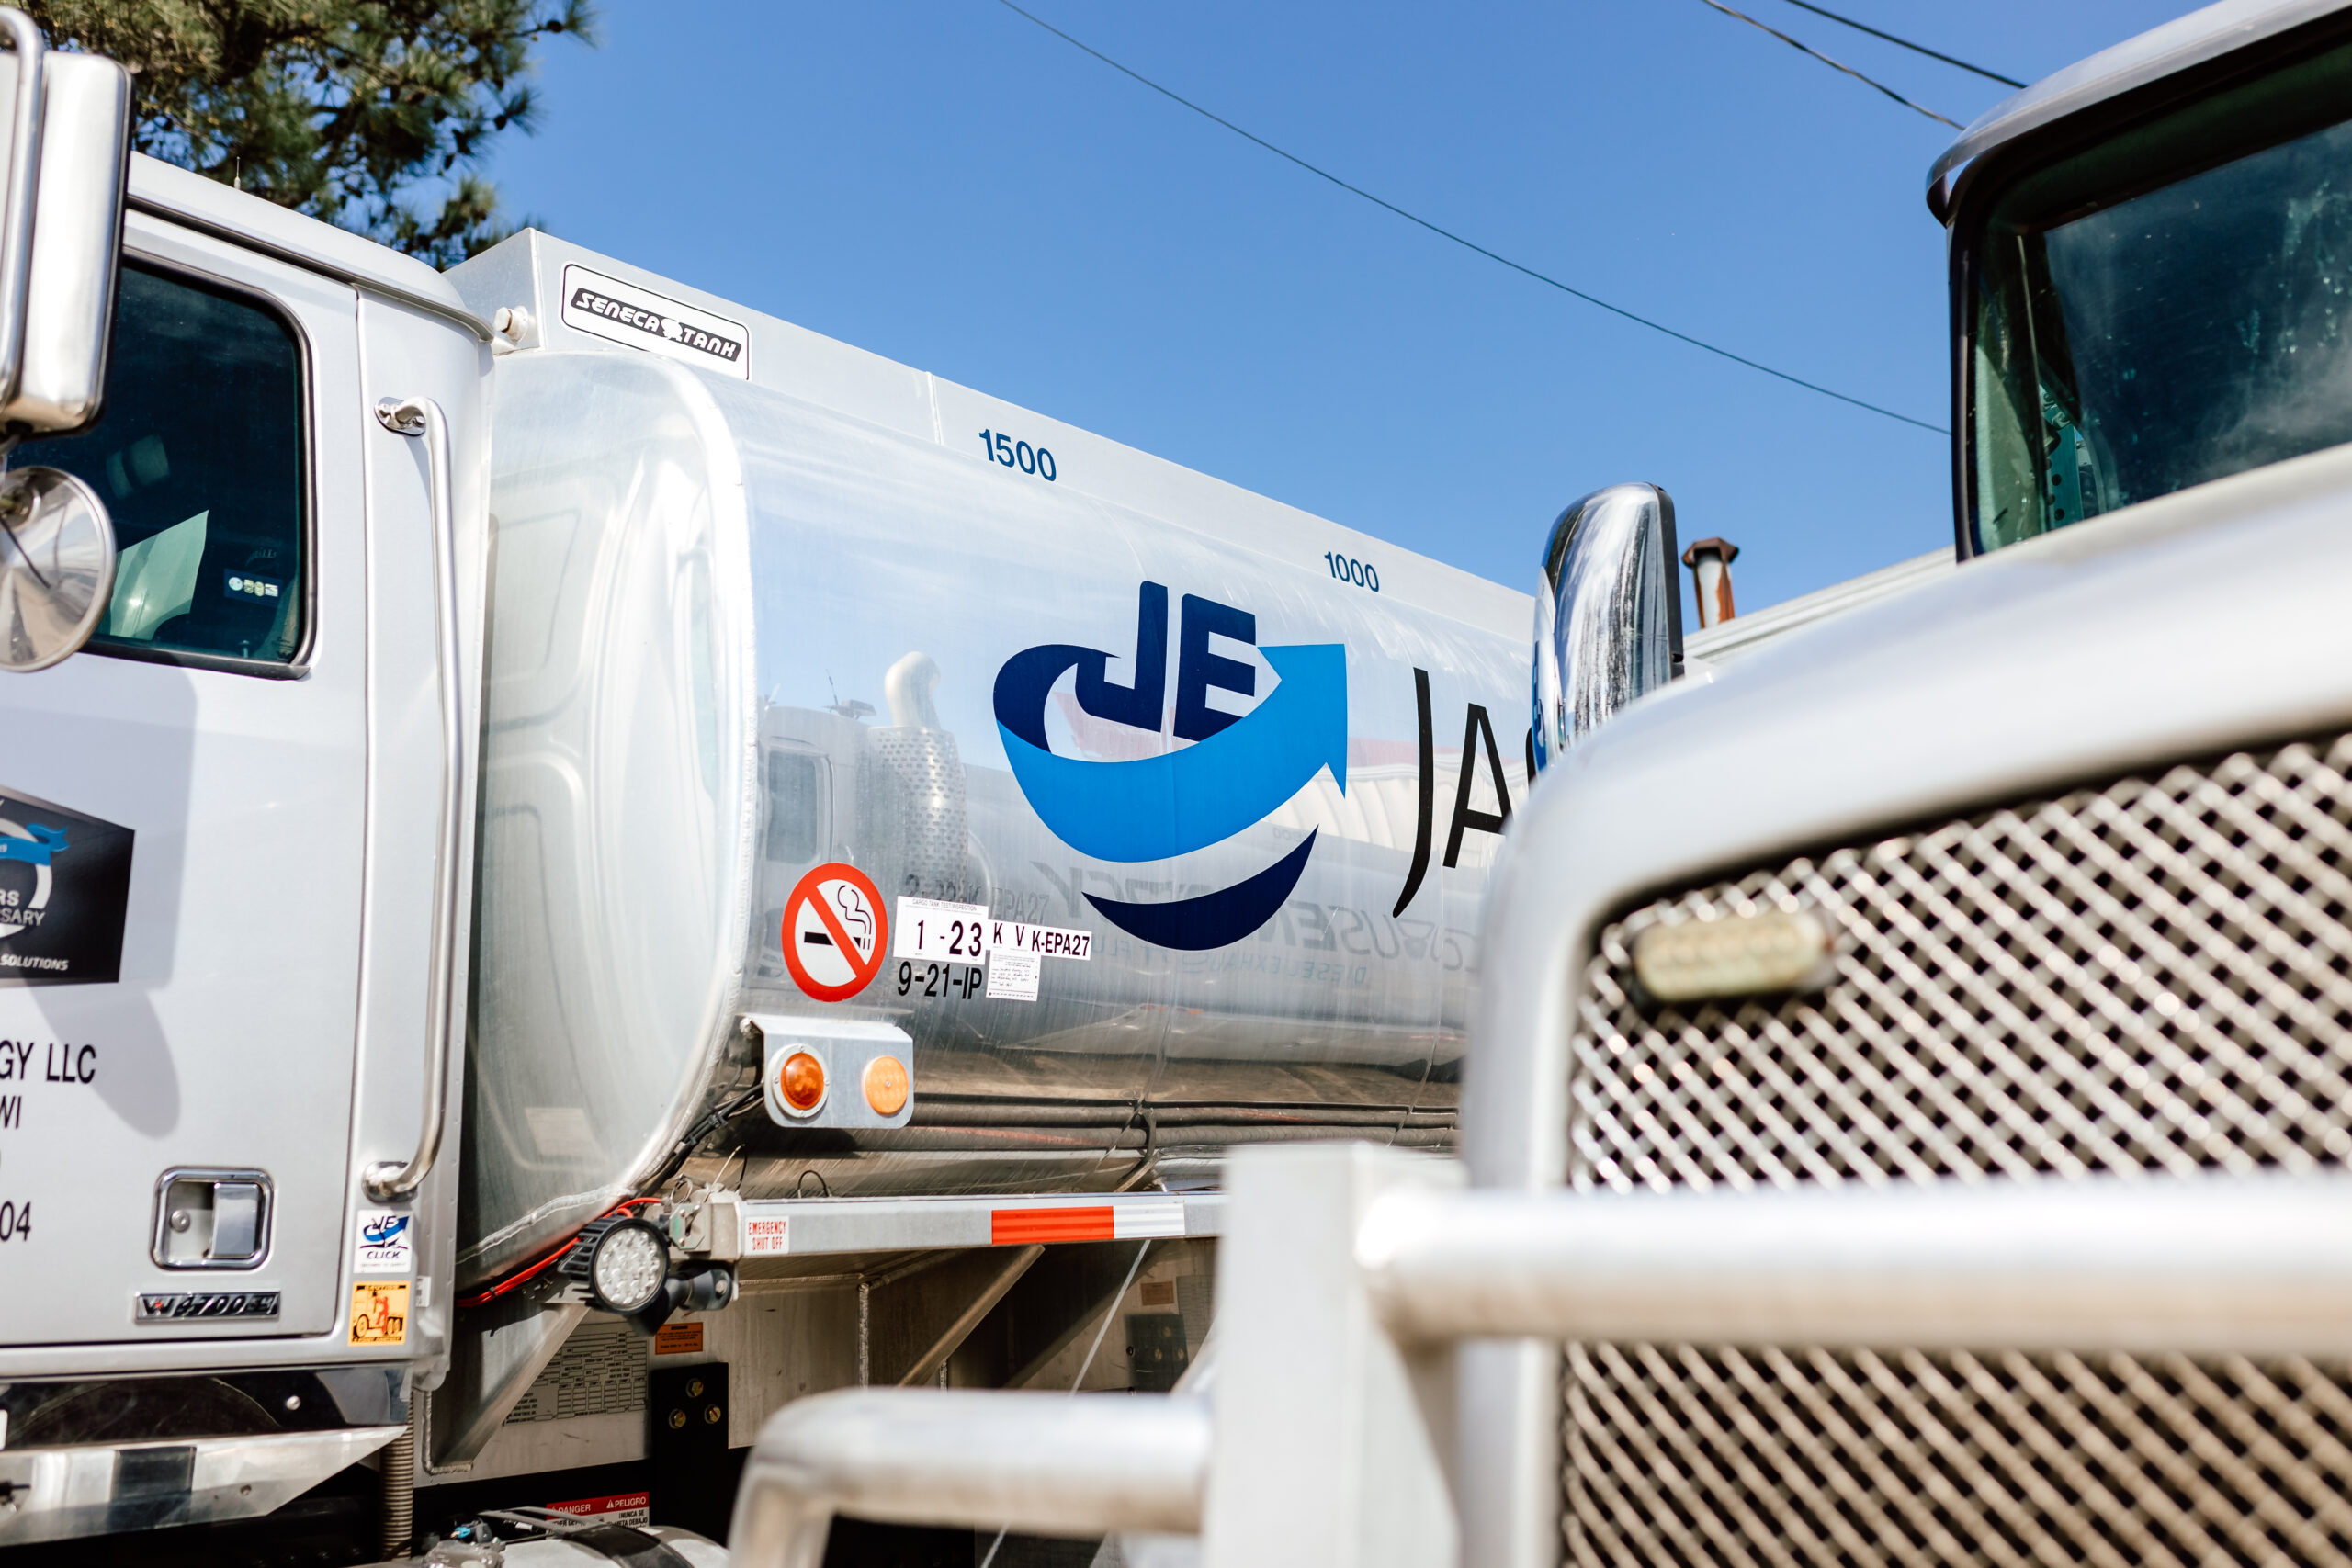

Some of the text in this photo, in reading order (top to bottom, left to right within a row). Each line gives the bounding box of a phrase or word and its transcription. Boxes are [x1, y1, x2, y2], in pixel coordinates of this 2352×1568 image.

[576, 292, 737, 358] SENECA TANK
[978, 428, 1057, 482] 1500
[1324, 550, 1379, 592] 1000
[1393, 667, 1534, 919] JA
[993, 922, 1091, 957] K V K-EPA27
[0, 953, 70, 972] SOLUTIONS
[898, 960, 983, 1000] 9-21-IP
[46, 1043, 97, 1085] LLC
[748, 1221, 786, 1235] EMERGENCY
[752, 1235, 783, 1251] SHUT OFF
[367, 1250, 401, 1260] CLICK
[558, 1504, 592, 1515] DANGER
[615, 1496, 647, 1508] PELIGRO
